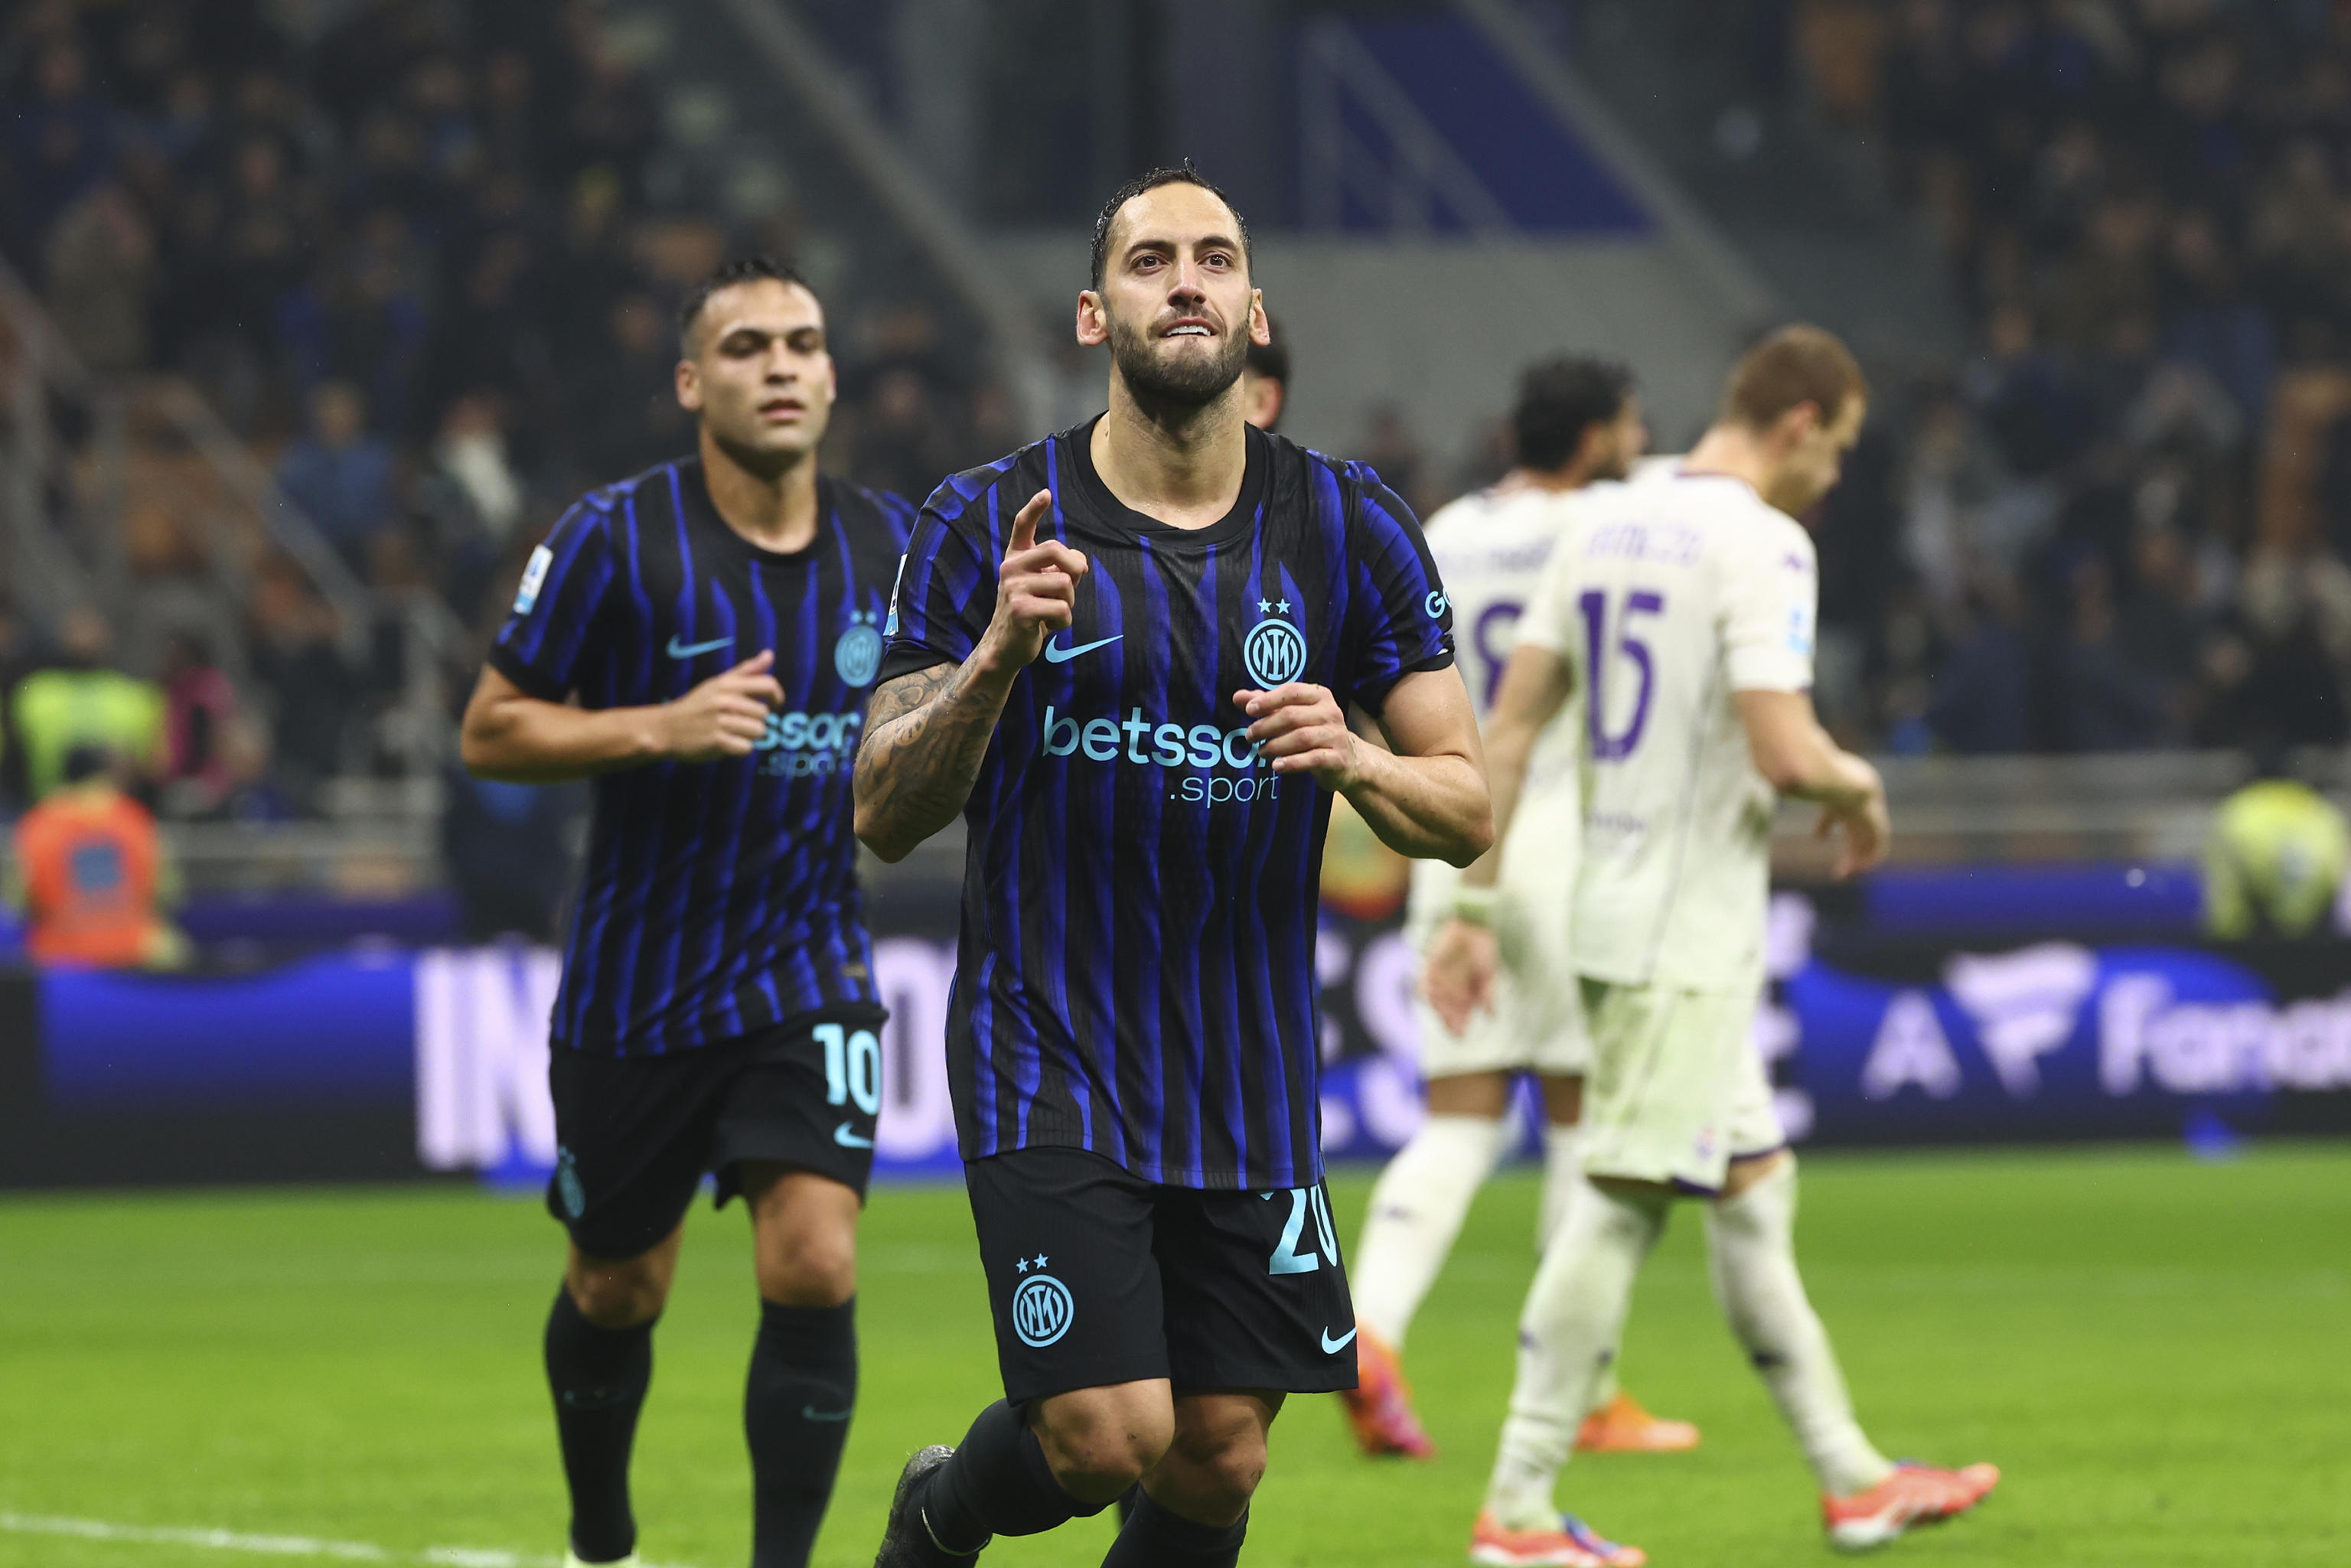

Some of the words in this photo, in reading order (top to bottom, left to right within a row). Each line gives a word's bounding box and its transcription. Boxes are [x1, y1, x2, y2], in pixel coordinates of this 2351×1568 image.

[1578, 591, 1664, 762] 15
[1042, 705, 1267, 769] betsso
[1169, 769, 1280, 809] .sport
[812, 1023, 882, 1116] 10
[2097, 973, 2351, 1096] Fana
